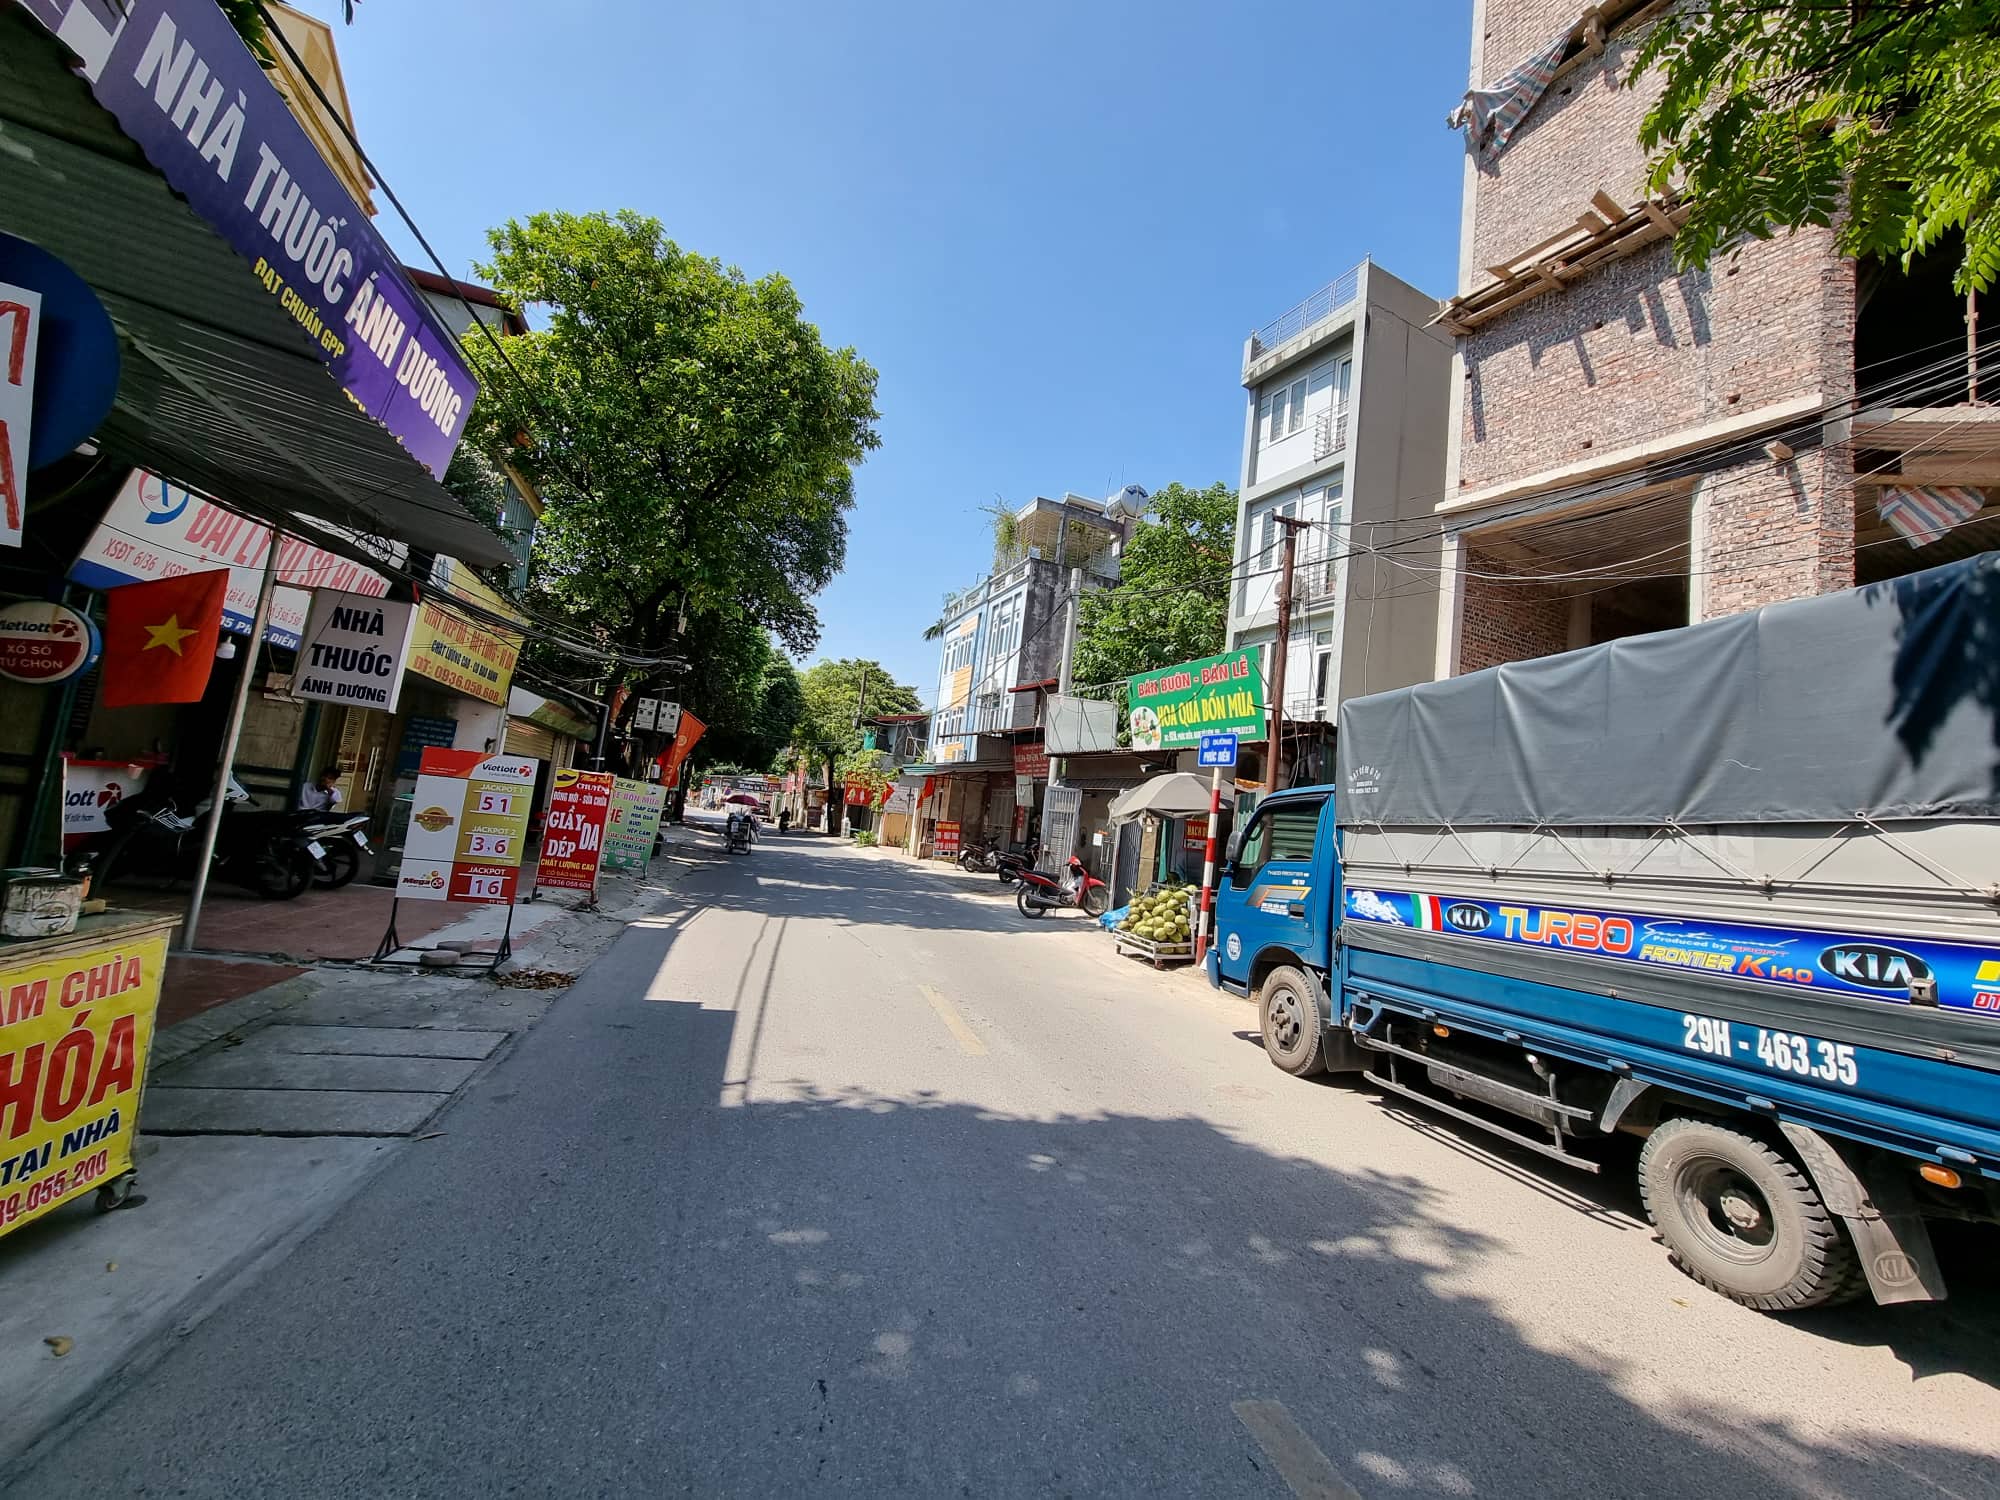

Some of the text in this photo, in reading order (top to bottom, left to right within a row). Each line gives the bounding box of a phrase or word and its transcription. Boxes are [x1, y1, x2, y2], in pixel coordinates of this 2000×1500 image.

[134, 11, 248, 183] NHÀ
[243, 142, 353, 304] THUỐC
[345, 271, 406, 369] ÁNH
[280, 286, 323, 339] CHUẨN
[320, 328, 345, 359] GPP
[133, 550, 159, 572] 6/36
[331, 608, 385, 636] NHÀ
[311, 643, 393, 677] THUỐC
[301, 675, 387, 703] ÁNH DƯƠNG
[1137, 679, 1158, 697] BÁN
[1160, 671, 1191, 694] BUÔN
[1201, 662, 1229, 685] BÁN
[1231, 655, 1249, 679] LẺ
[1157, 686, 1256, 728] HOA QUẢ BỐN MÙA
[482, 762, 517, 774] Vietlott
[480, 784, 518, 794] JACKPOT
[472, 826, 517, 836] JACKPOT 2
[548, 804, 586, 831] GIẦY
[546, 836, 576, 858] DÉP
[579, 822, 600, 852] DA
[468, 866, 507, 876] JACKPOT
[581, 863, 595, 872] CAO
[1451, 906, 1635, 955] KIA TURBO
[1652, 935, 1709, 948] Produced
[1712, 940, 1728, 952] by
[1638, 944, 1737, 973] FRONTIER
[1737, 955, 1772, 977] K
[1833, 949, 1913, 987] KIA
[60, 955, 141, 1009] CHÌA
[1682, 1014, 1732, 1059] 29H
[1756, 1029, 1858, 1087] 463.35
[1, 1108, 119, 1187] TẠI NHÀ
